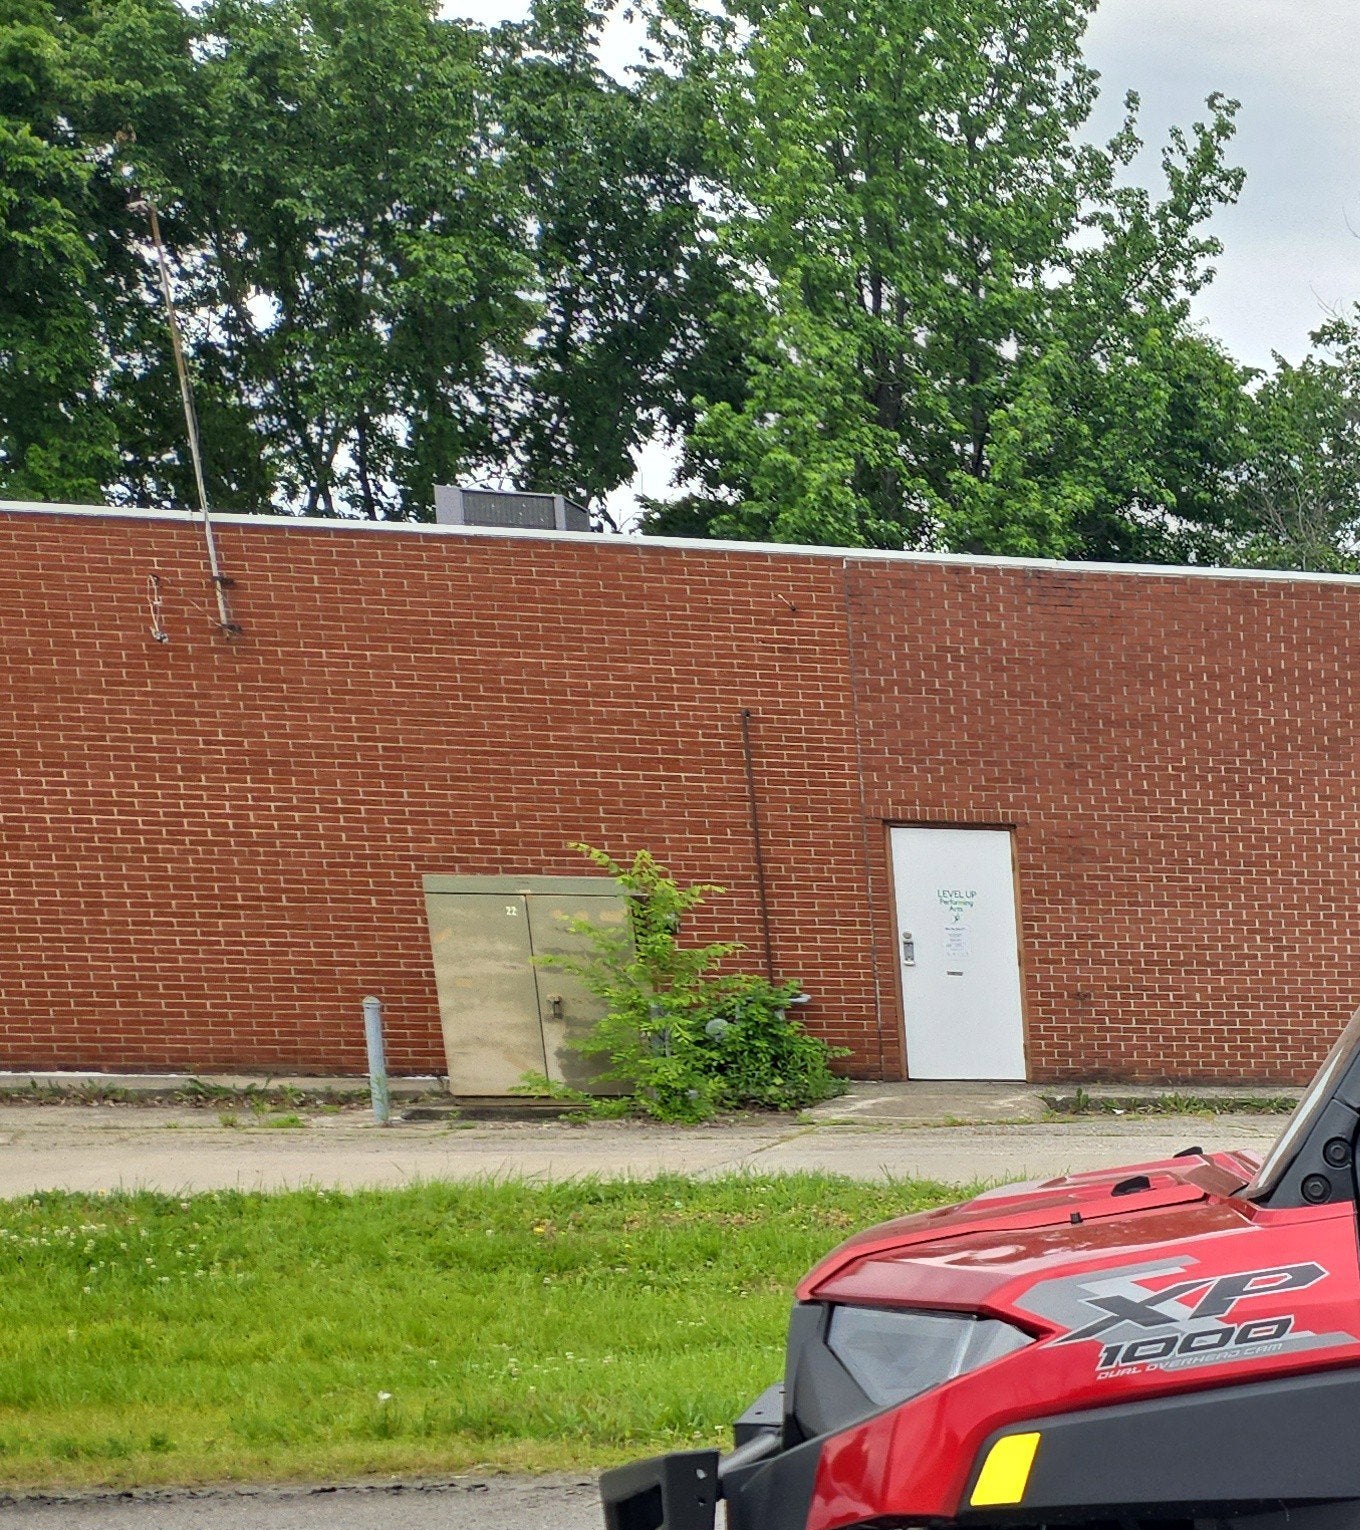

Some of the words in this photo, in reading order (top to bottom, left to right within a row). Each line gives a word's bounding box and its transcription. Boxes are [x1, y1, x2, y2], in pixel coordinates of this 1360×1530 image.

[505, 906, 517, 916] 22
[937, 889, 964, 899] LEVEL
[965, 890, 977, 899] UP
[1039, 1261, 1330, 1350] XP
[1096, 1314, 1295, 1371] 1000
[1096, 1366, 1142, 1381] DUAL
[1145, 1348, 1242, 1372] OVERHEAD
[1243, 1342, 1283, 1356] CAM
